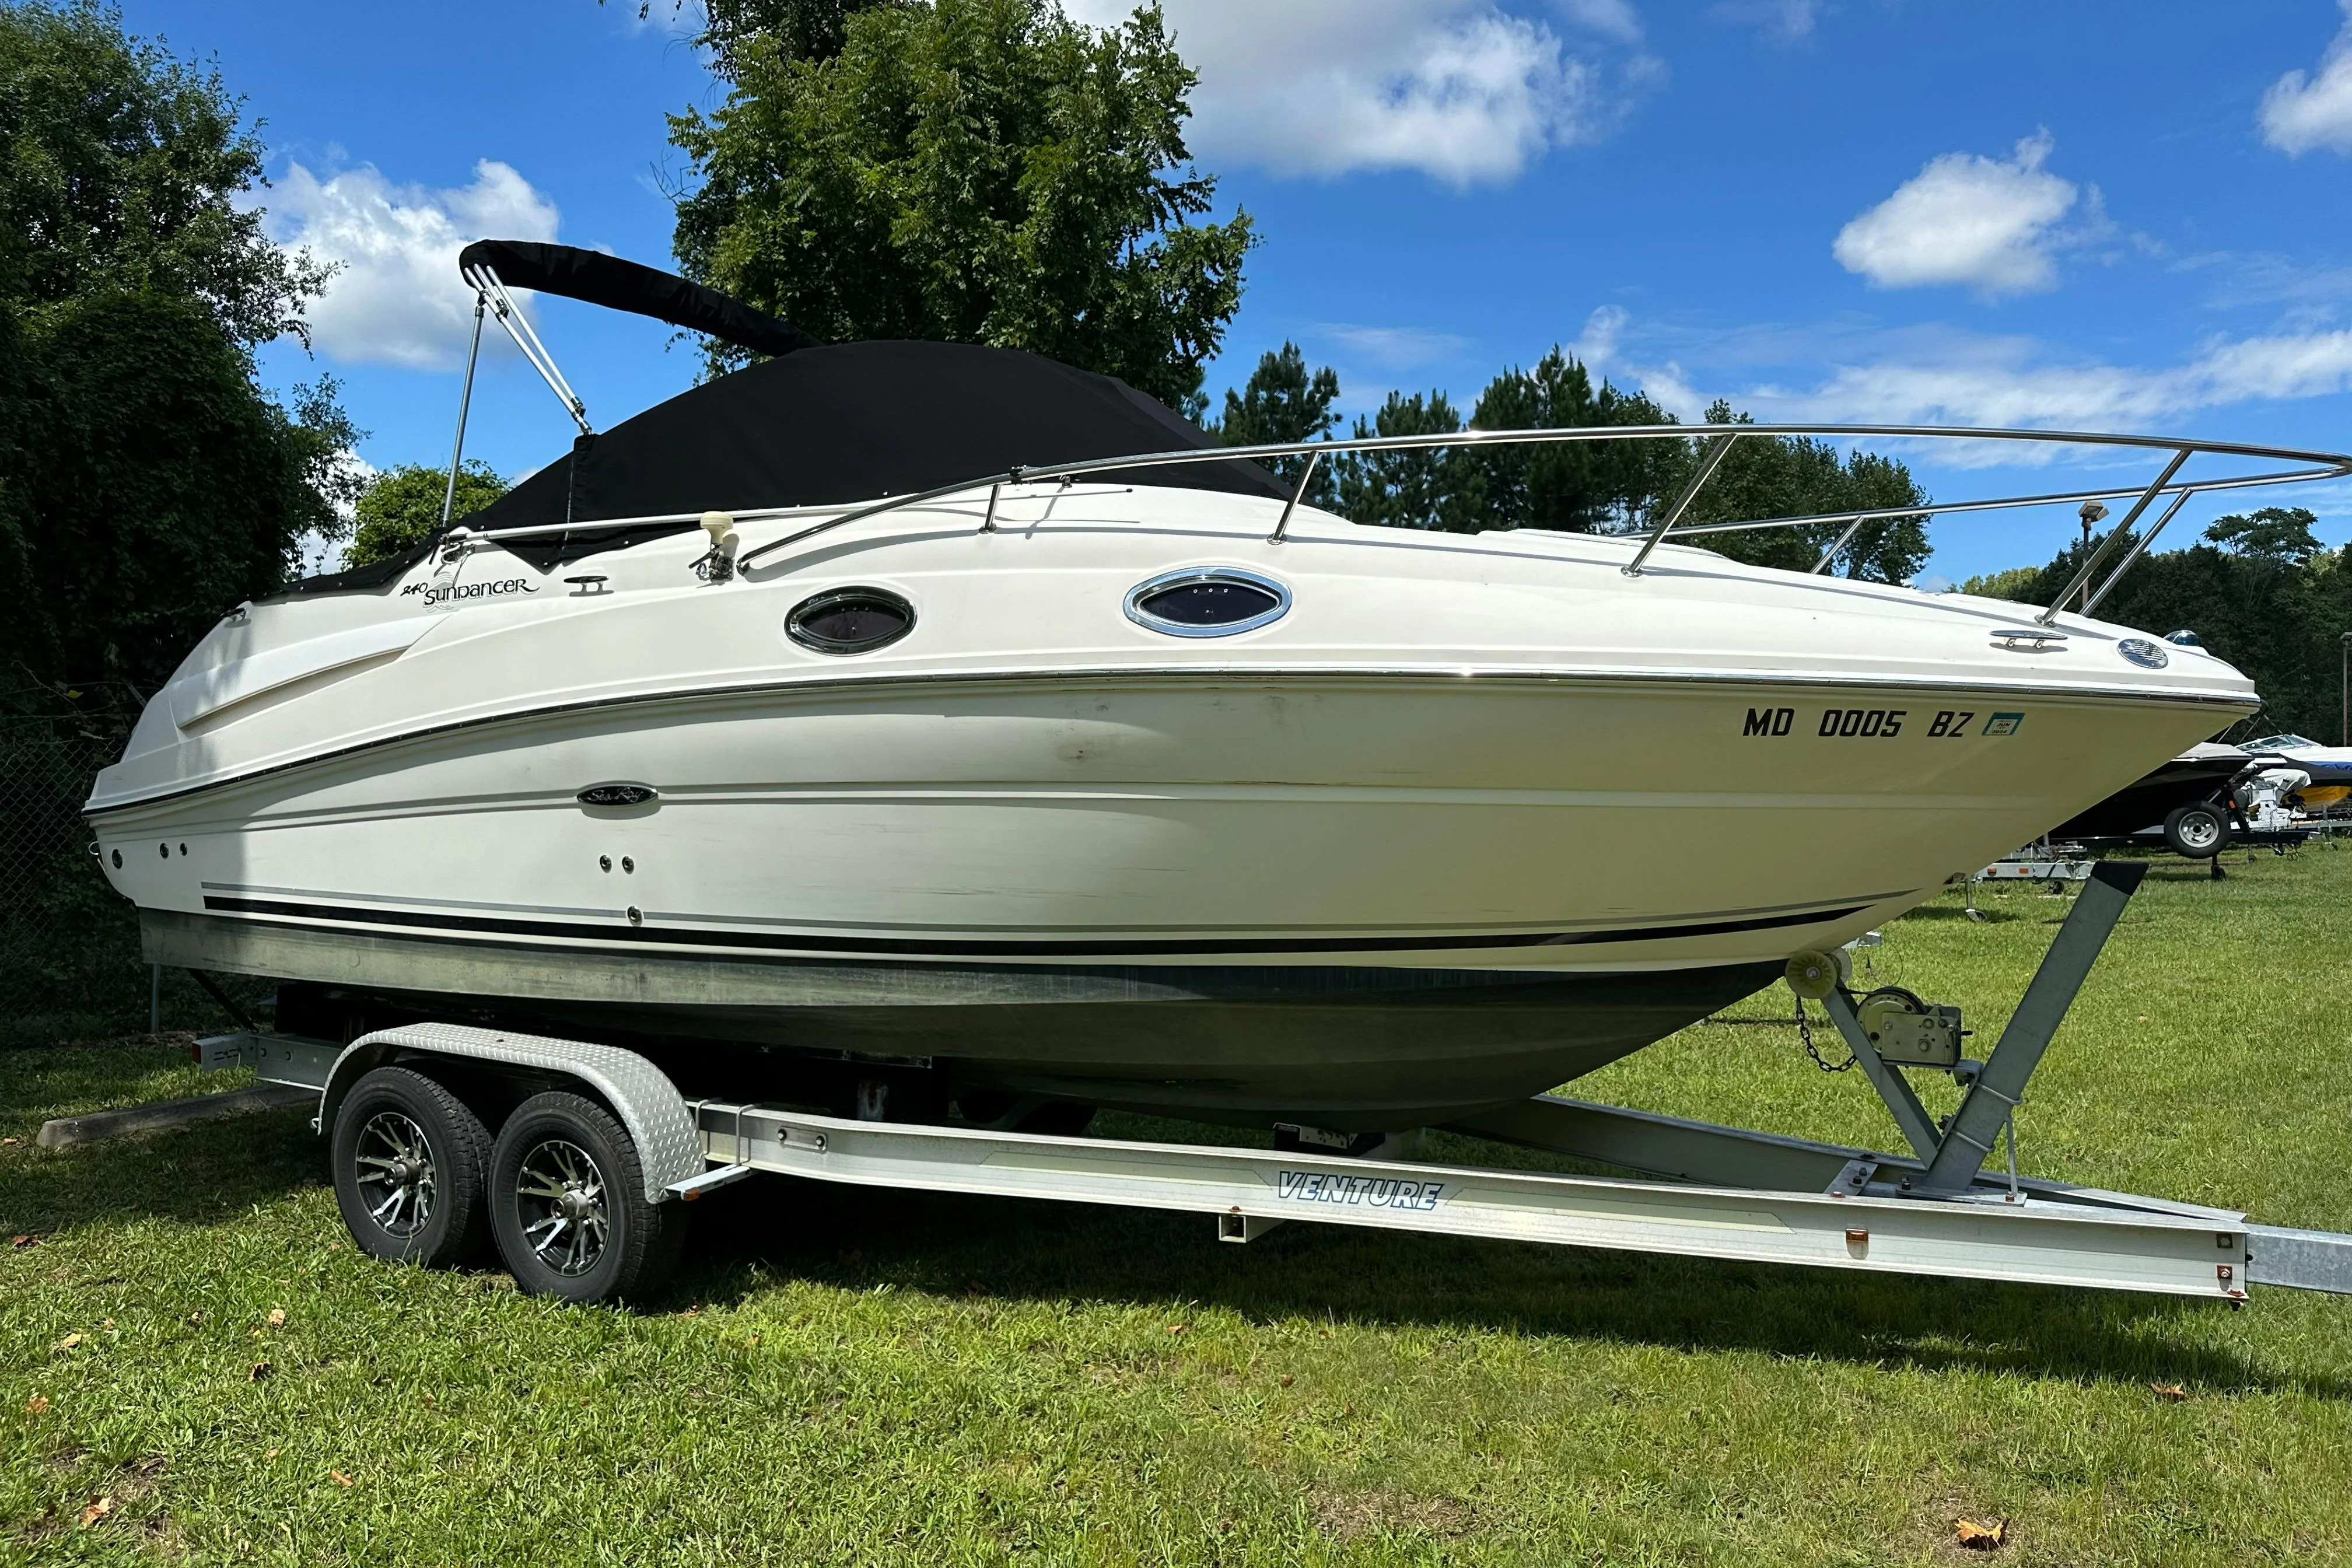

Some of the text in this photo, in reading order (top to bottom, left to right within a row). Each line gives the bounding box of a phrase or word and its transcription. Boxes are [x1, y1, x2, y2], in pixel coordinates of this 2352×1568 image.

[400, 582, 428, 597] 240
[1742, 708, 1975, 737] MD 0005 BZ
[587, 786, 644, 803] Sea Ray
[1278, 1170, 1445, 1211] VENTURE
